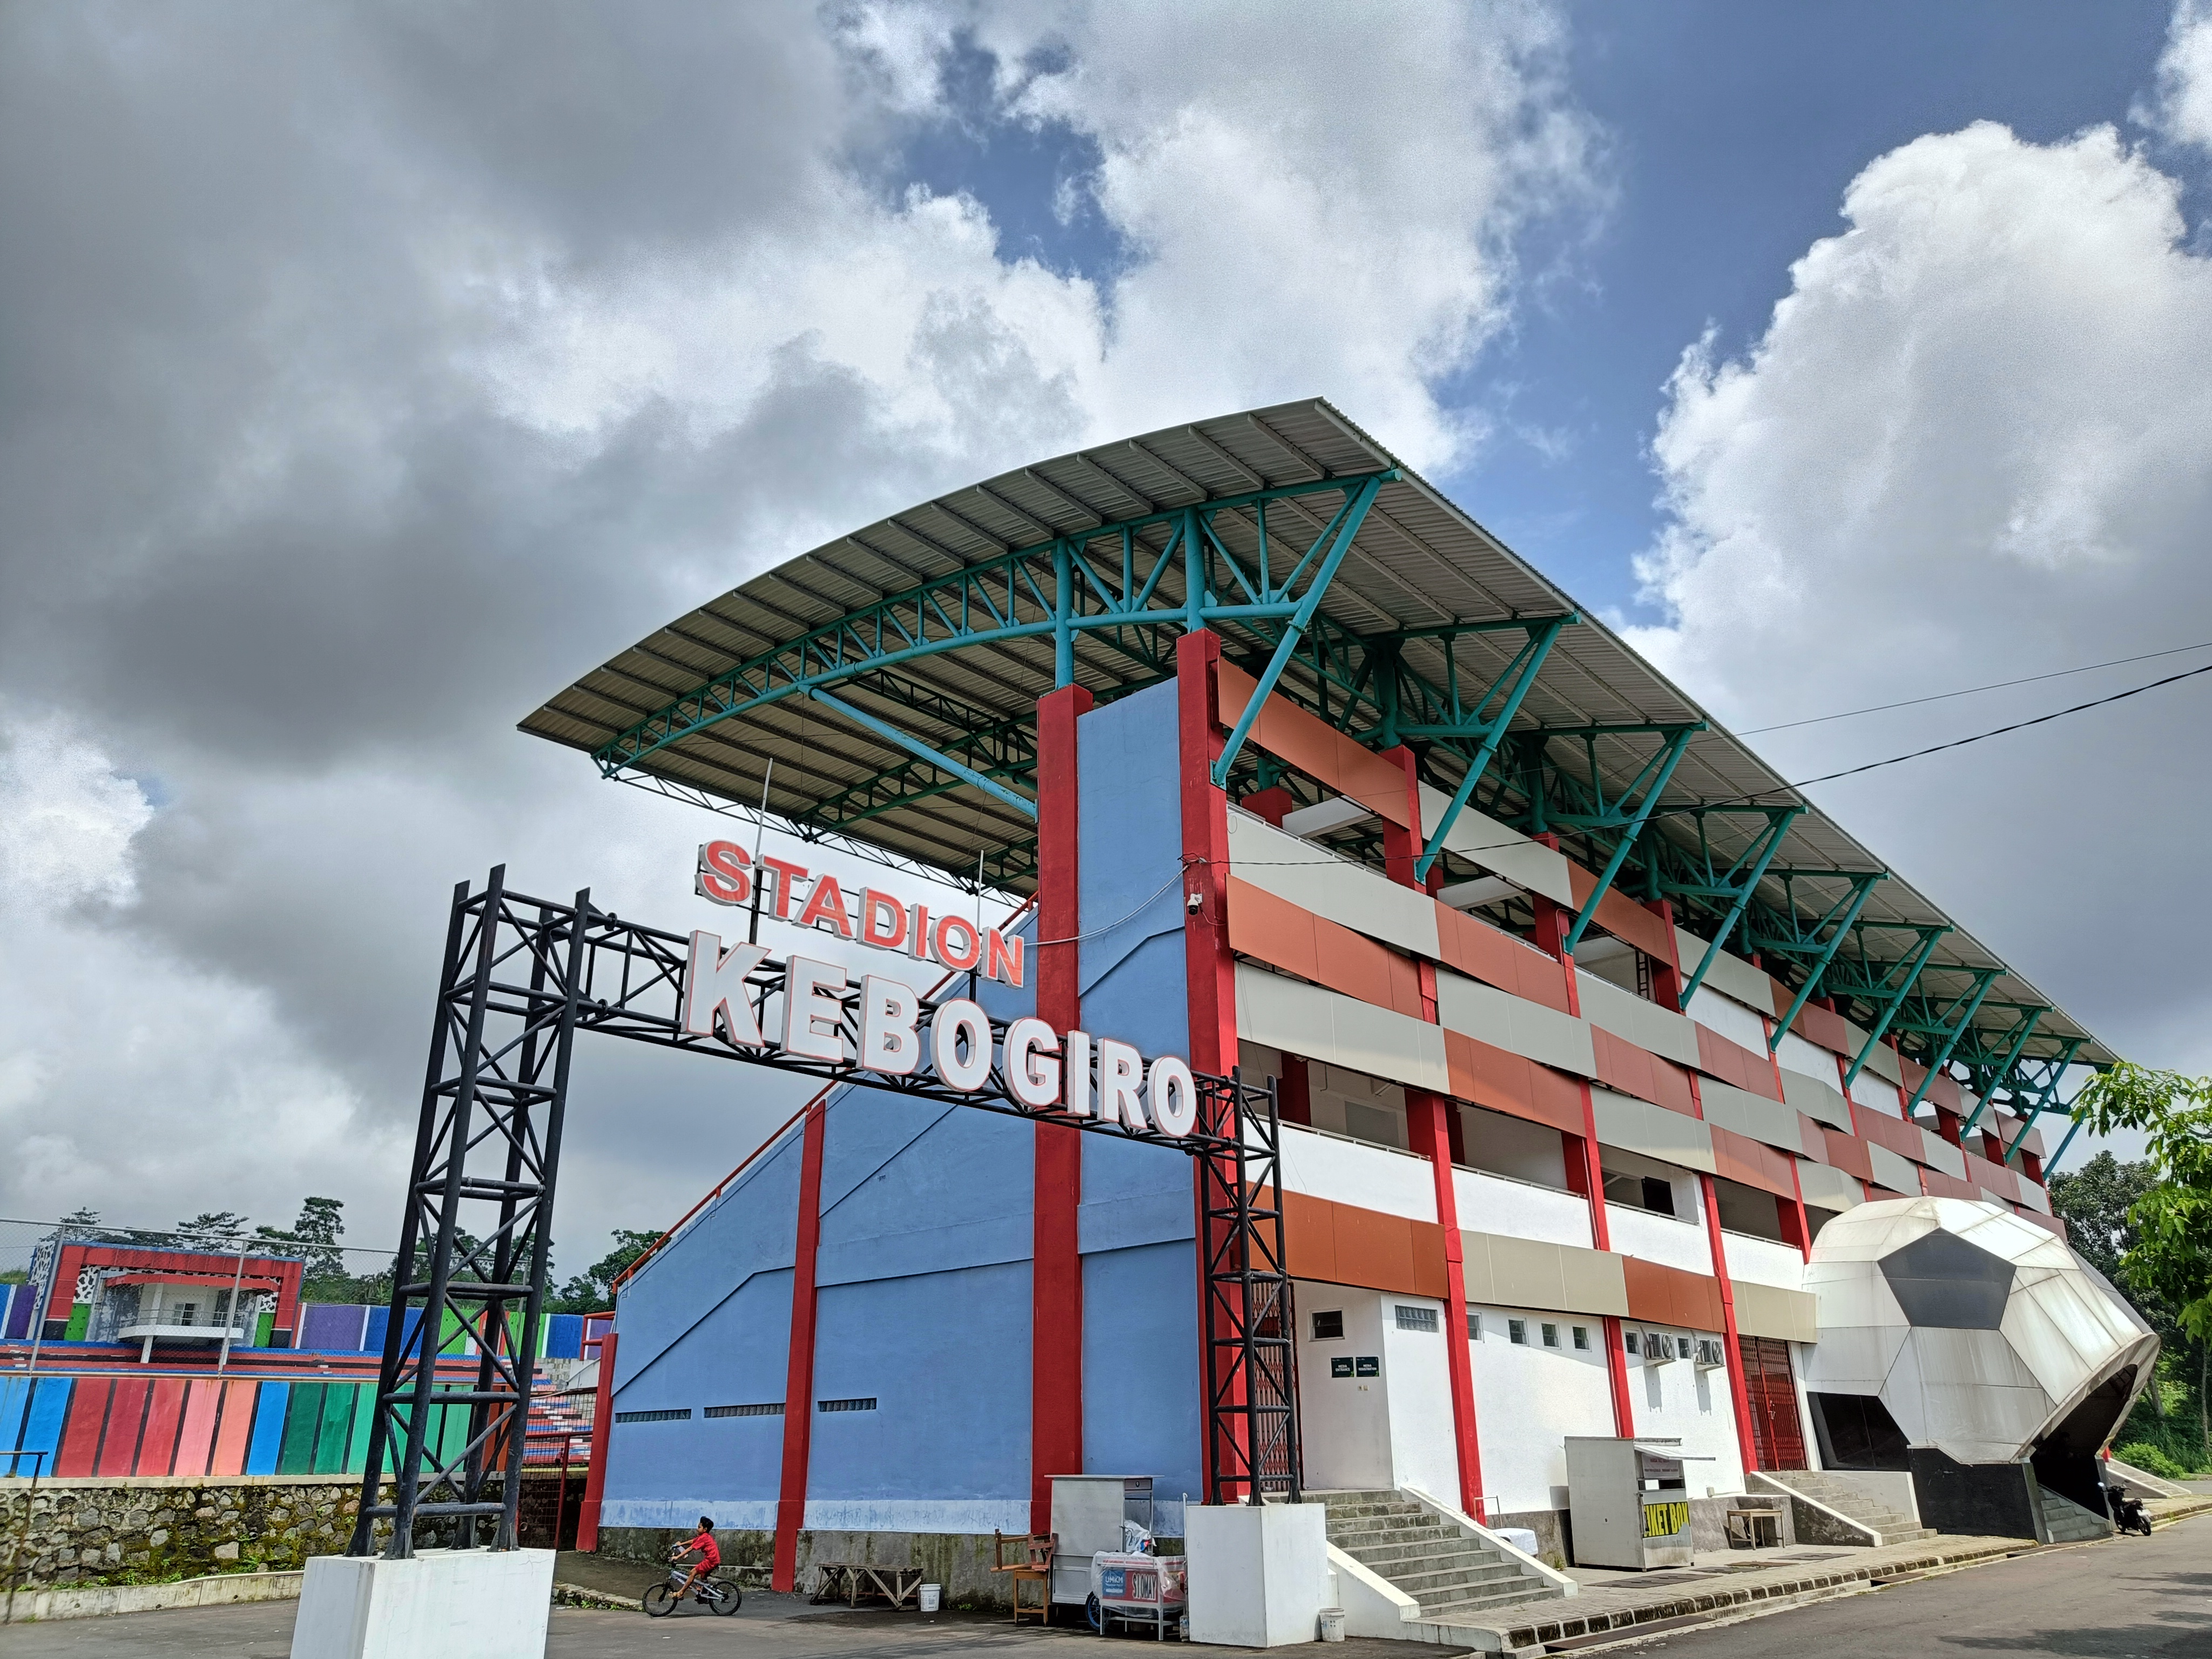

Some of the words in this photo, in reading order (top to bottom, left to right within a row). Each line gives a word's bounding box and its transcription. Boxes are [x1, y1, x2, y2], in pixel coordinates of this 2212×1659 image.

[695, 839, 1024, 989] STADION
[680, 929, 1197, 1138] KEBOGIRO
[1132, 1573, 1157, 1601] SIOMAY
